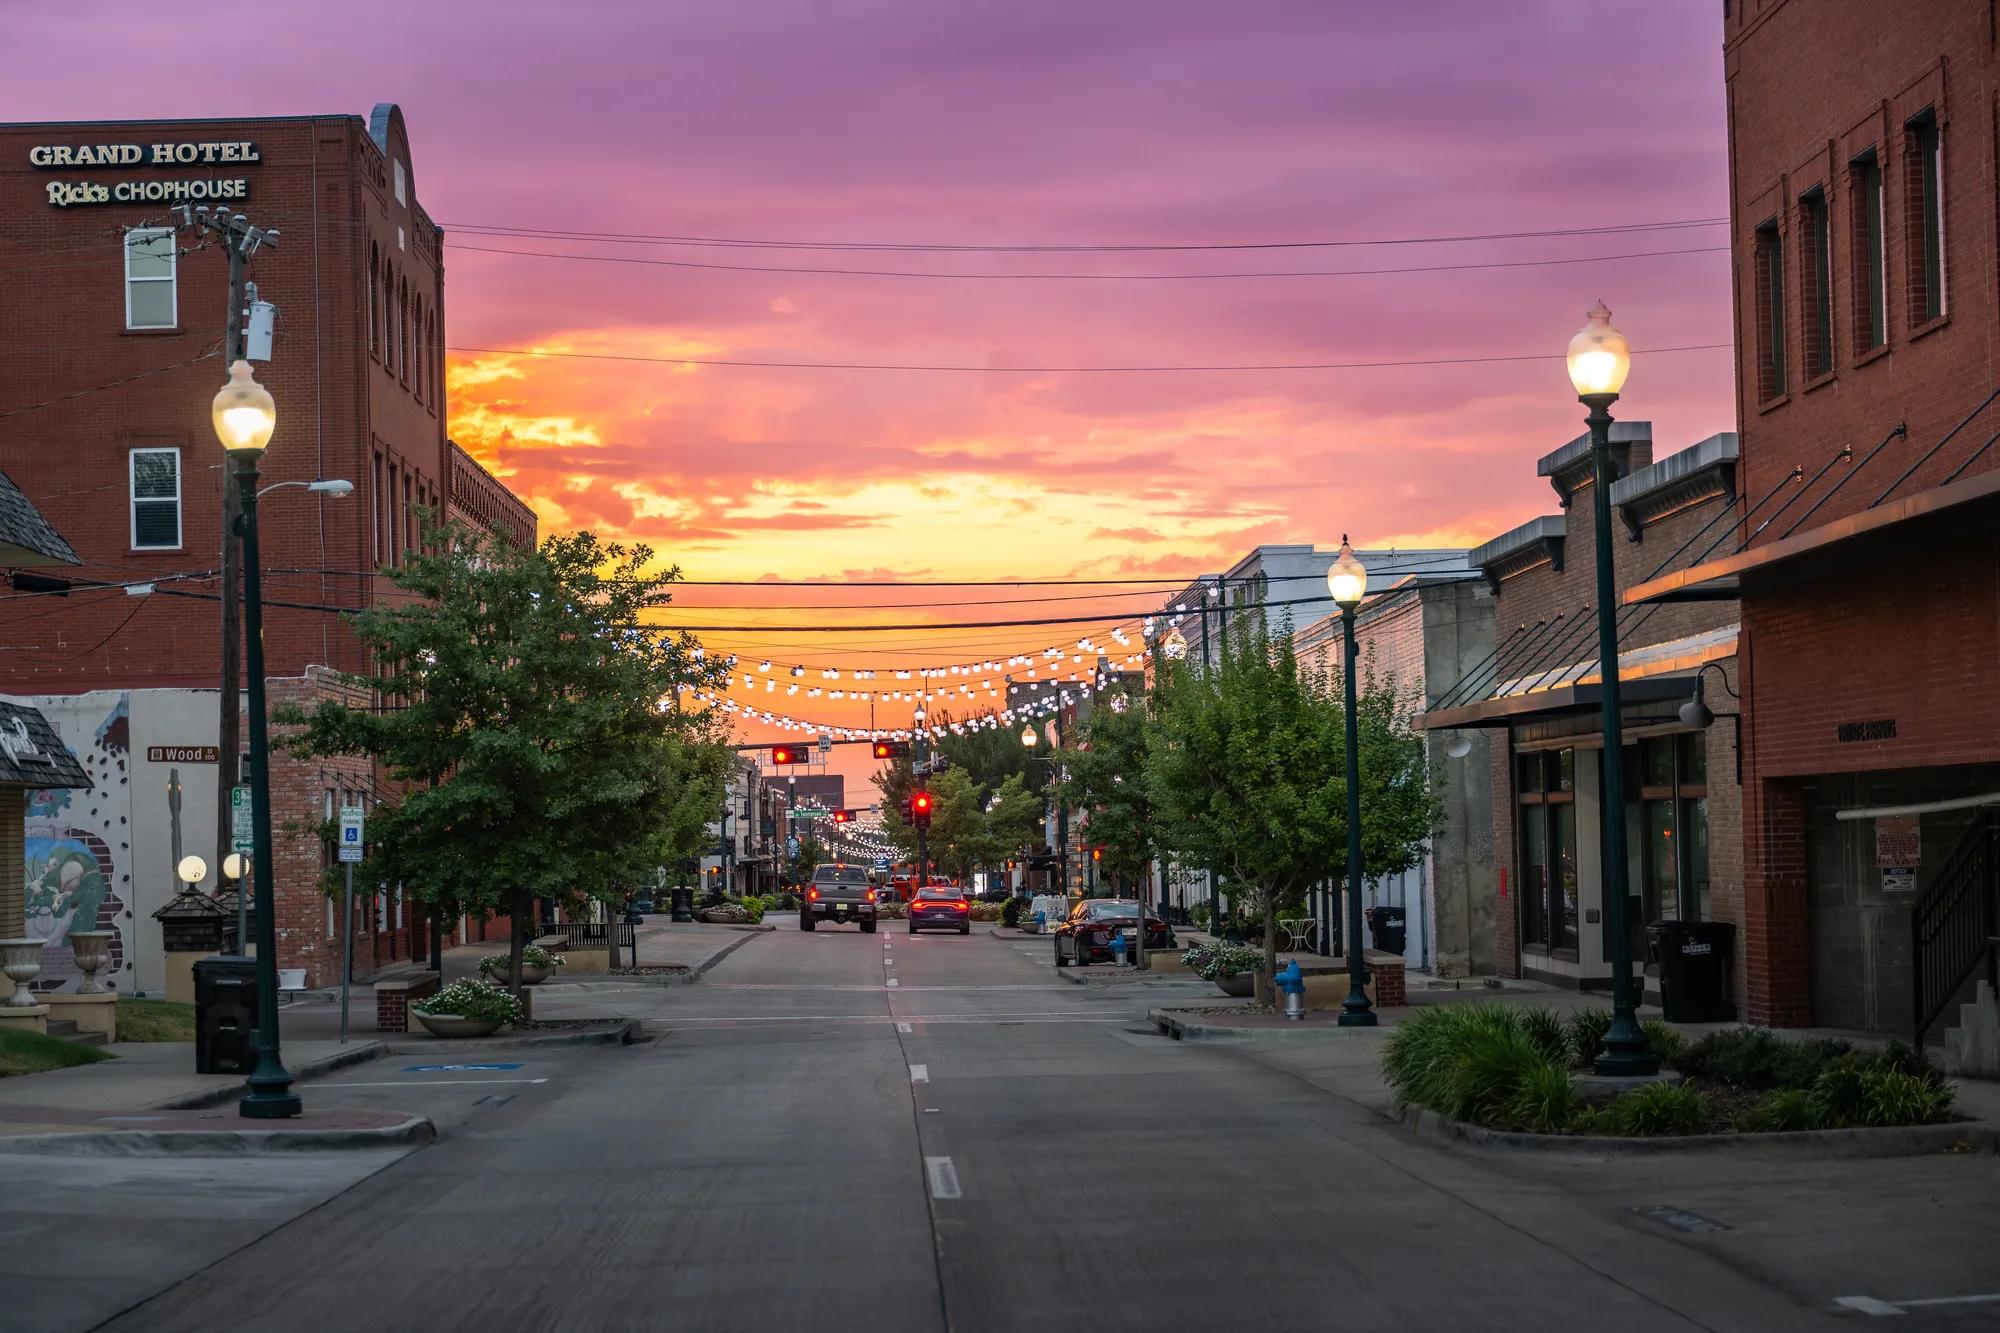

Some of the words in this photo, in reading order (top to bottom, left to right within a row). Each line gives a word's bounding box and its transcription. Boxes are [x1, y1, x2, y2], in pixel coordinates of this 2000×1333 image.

[30, 144, 143, 166] GRAND
[151, 142, 259, 163] HOTEL
[46, 181, 110, 206] Rick's
[114, 179, 246, 201] CHOPHOUSE
[166, 747, 202, 761] Wood
[234, 791, 241, 804] 3
